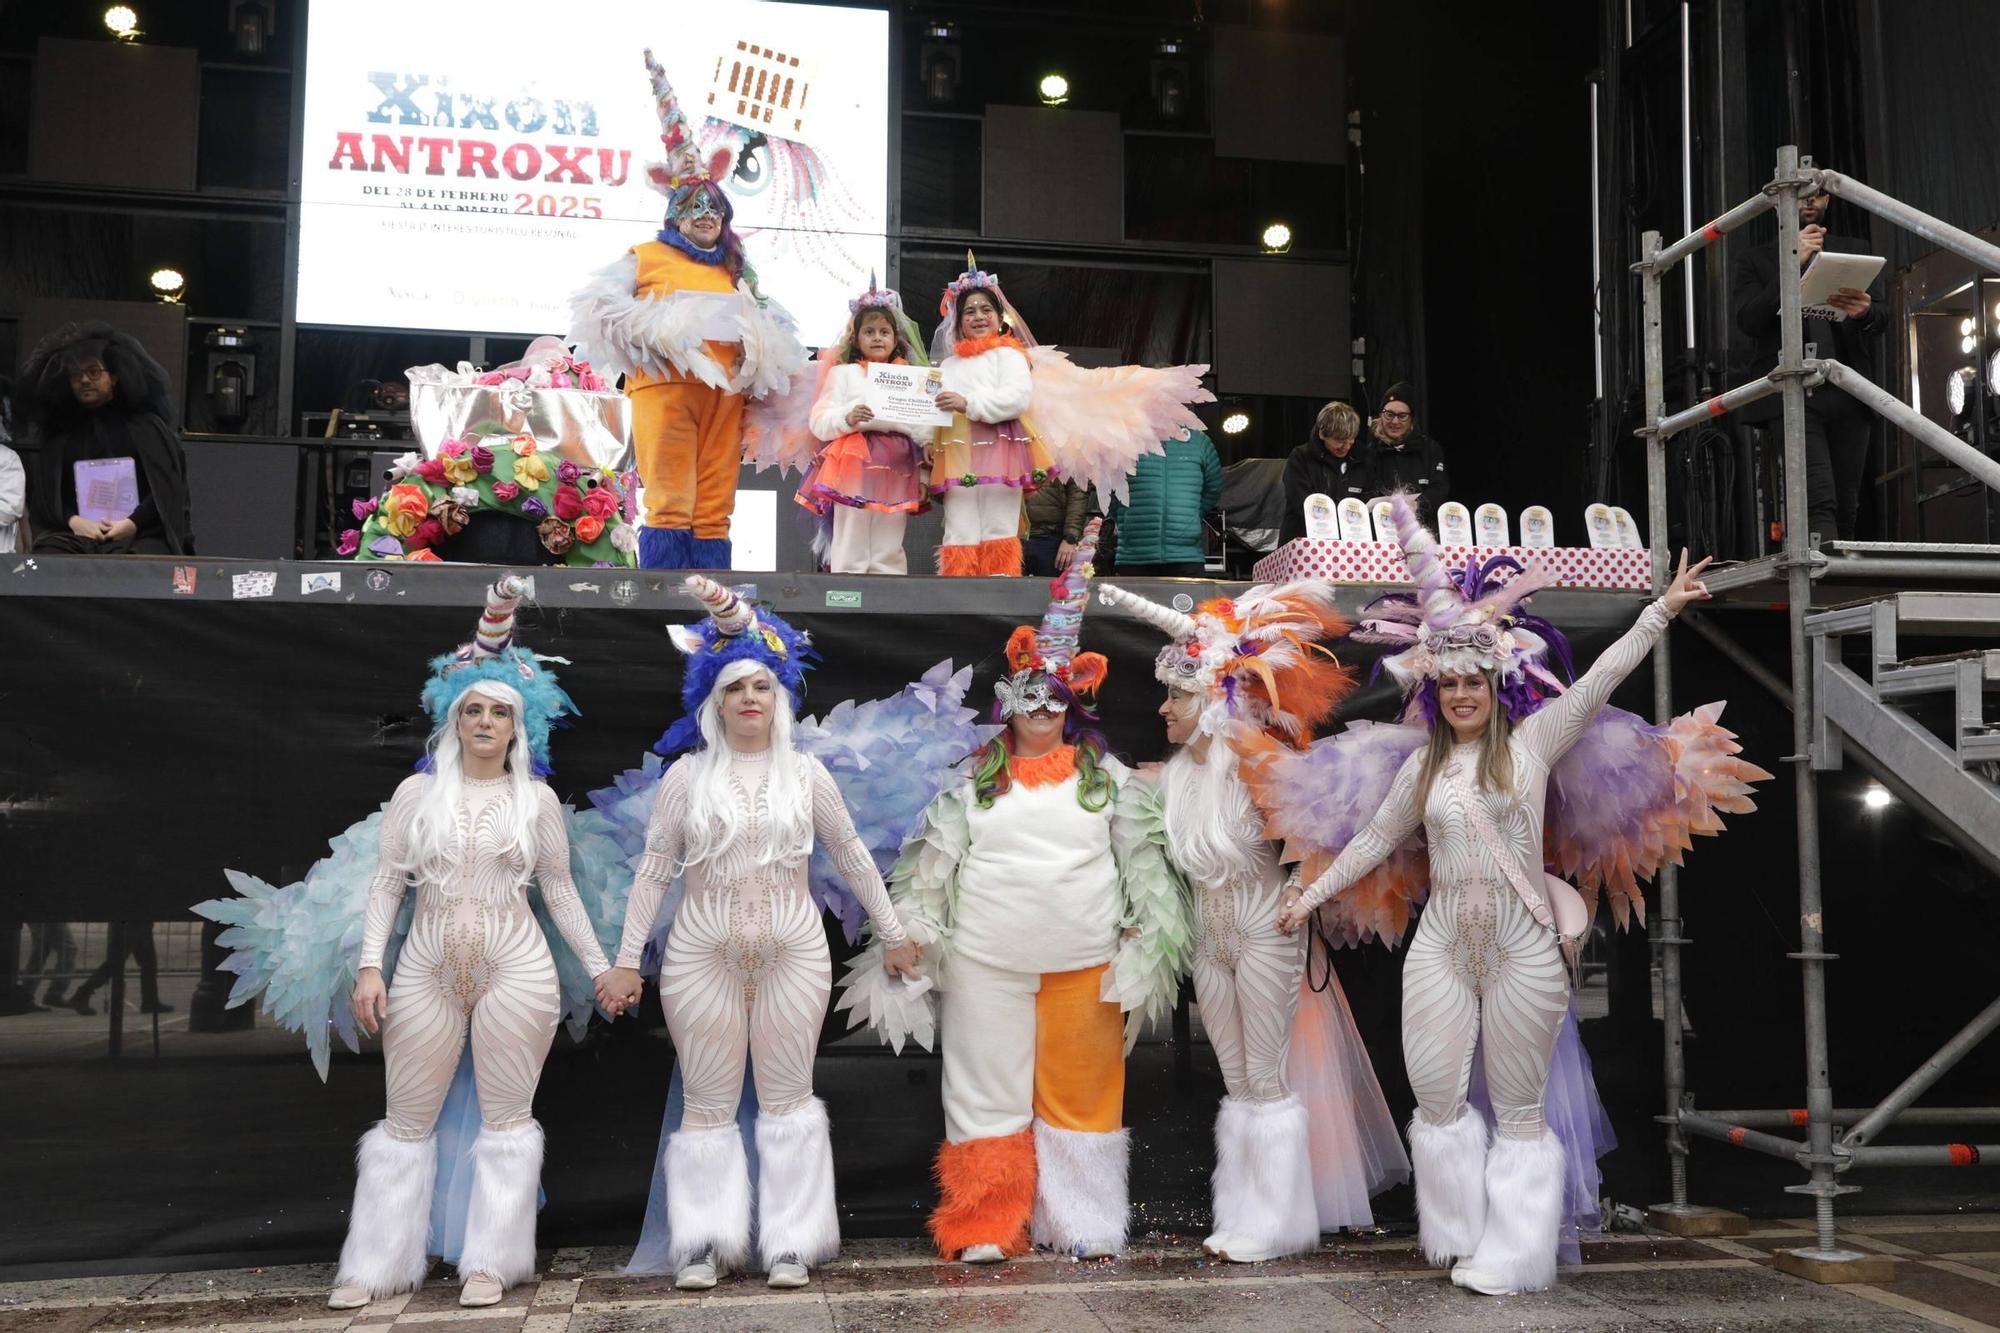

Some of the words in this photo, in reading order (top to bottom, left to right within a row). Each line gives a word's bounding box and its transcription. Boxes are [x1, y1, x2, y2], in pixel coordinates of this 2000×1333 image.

[366, 70, 600, 137] Xixón
[328, 131, 632, 187] ANTROXU
[362, 185, 391, 196] DEL
[396, 187, 412, 198] 28
[416, 188, 437, 199] DE
[514, 192, 603, 219] 2025
